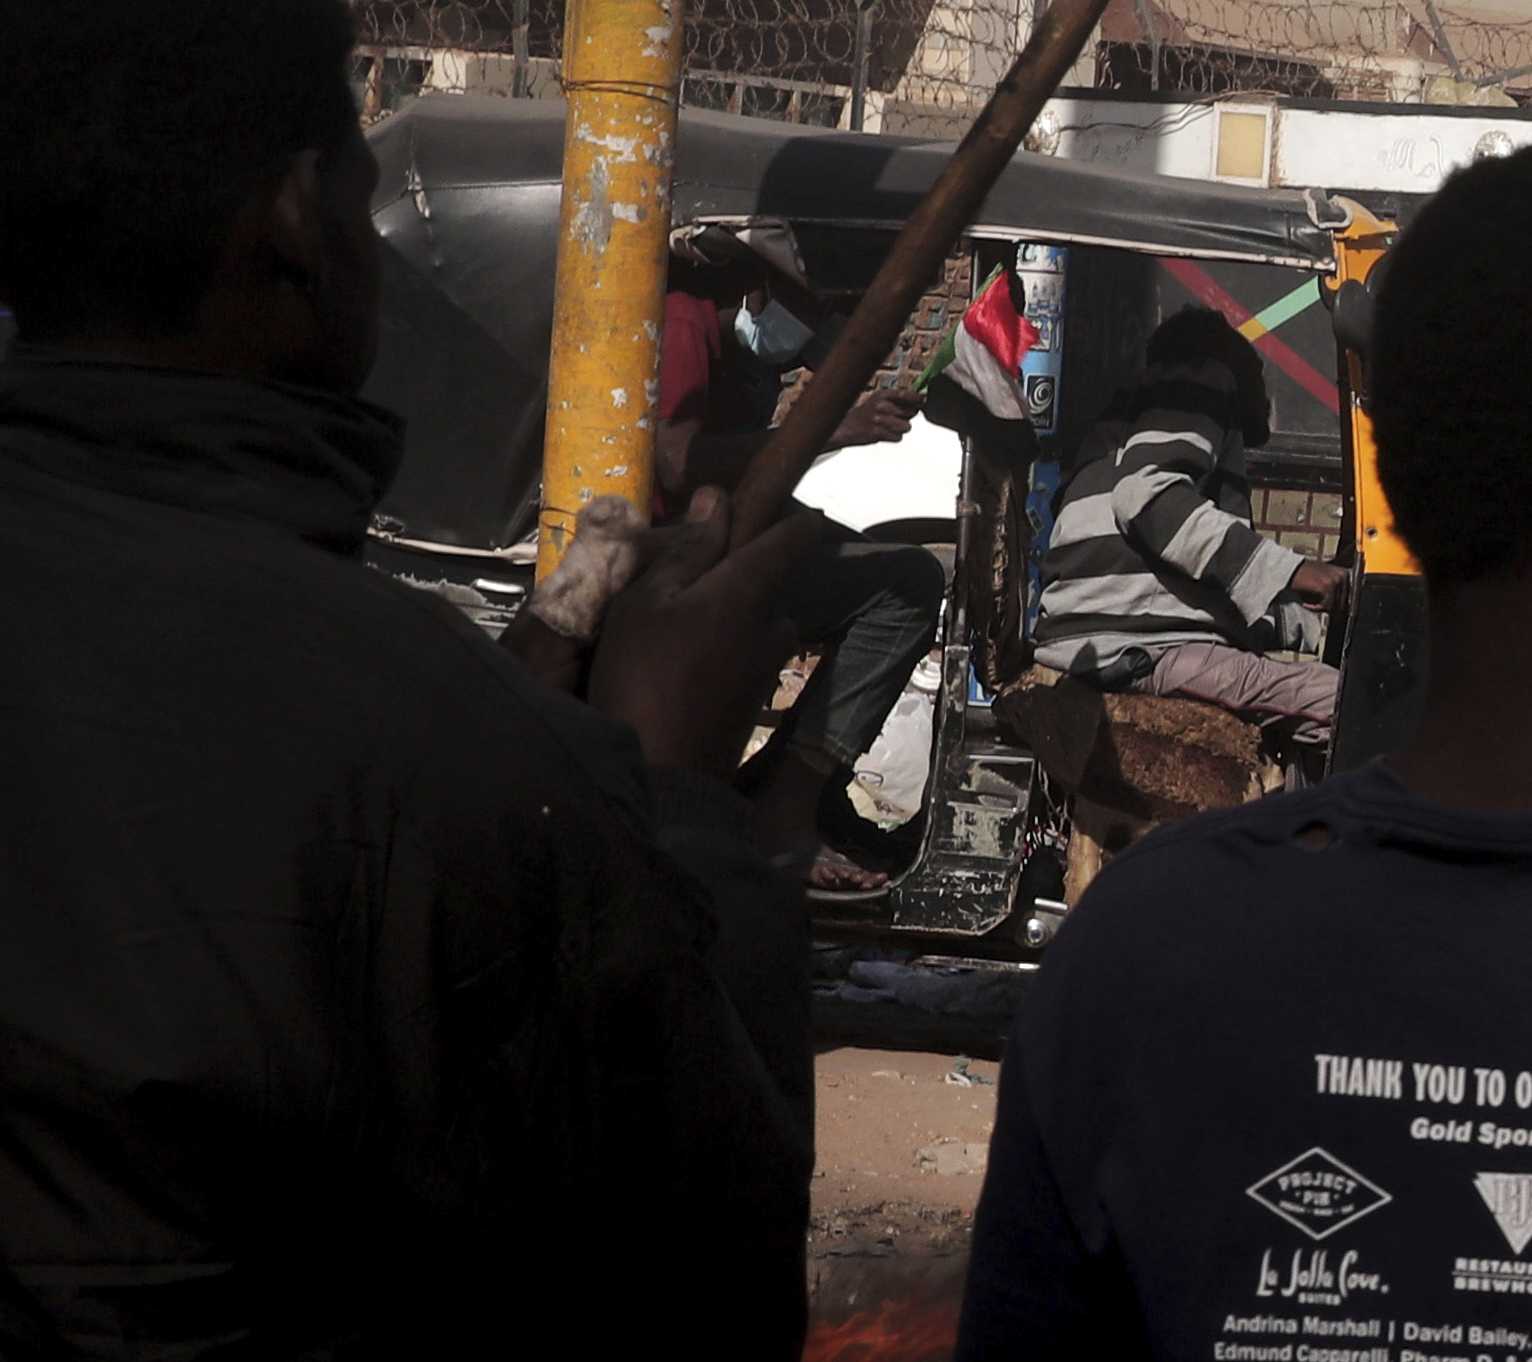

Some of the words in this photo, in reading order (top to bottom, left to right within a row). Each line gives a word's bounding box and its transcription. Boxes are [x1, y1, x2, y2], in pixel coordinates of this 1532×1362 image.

[1314, 1054, 1403, 1099] THANK
[1412, 1062, 1466, 1105] YOU
[1474, 1068, 1506, 1107] TO
[1409, 1117, 1473, 1143] Gold
[1278, 1171, 1357, 1195] PROJECT
[1256, 1247, 1279, 1297] La
[1280, 1247, 1334, 1297] Jolla
[1298, 1292, 1341, 1306] SUITES
[1223, 1314, 1297, 1334] Andrina
[1303, 1316, 1380, 1337] Marshall
[1403, 1321, 1463, 1343] David
[1213, 1342, 1293, 1362] Edmund
